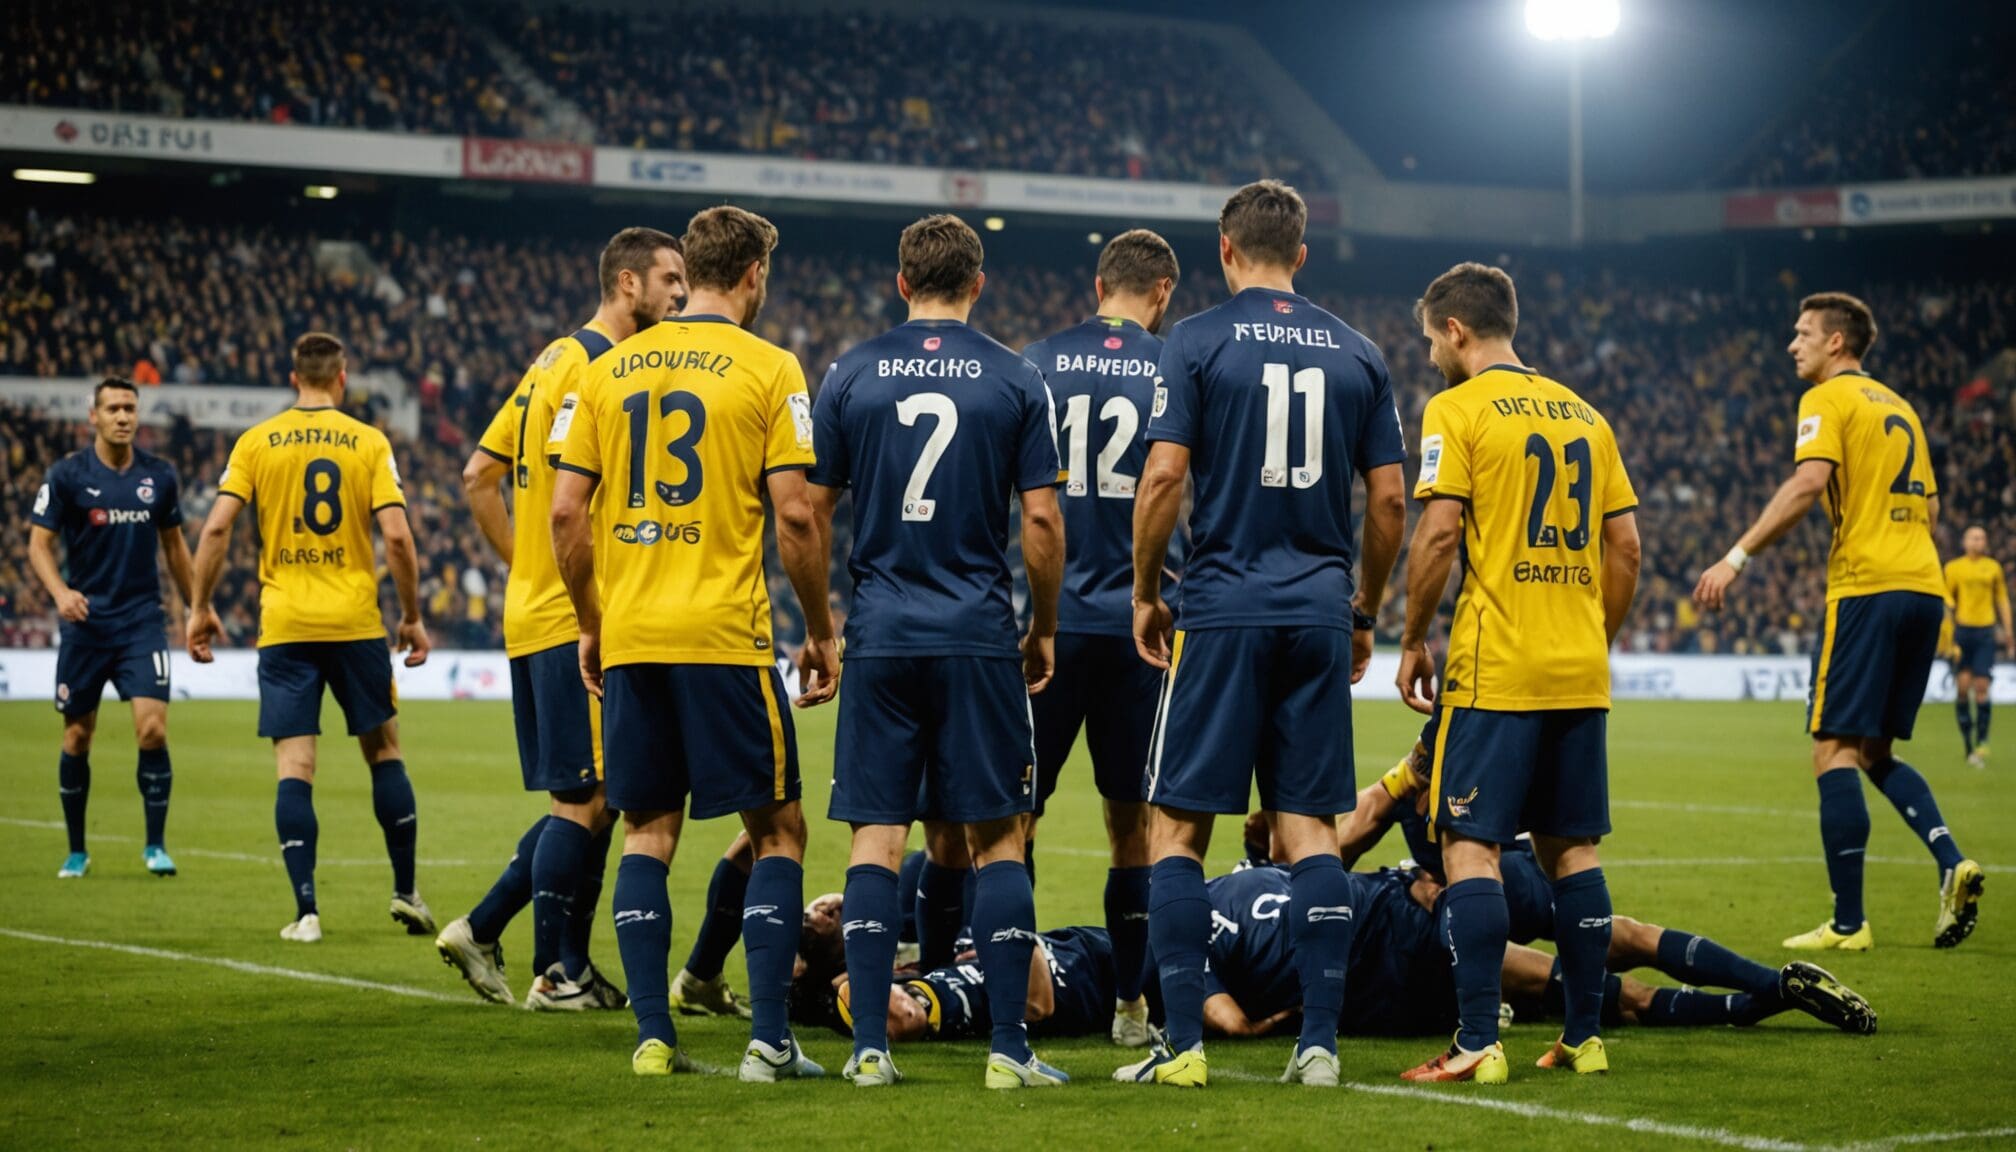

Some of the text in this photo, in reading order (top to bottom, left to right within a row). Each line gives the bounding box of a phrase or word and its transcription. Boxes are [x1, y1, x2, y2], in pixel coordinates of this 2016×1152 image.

[622, 390, 706, 508] 13
[1061, 395, 1139, 499] 12
[1261, 363, 1326, 489] 11
[303, 457, 343, 536] 8
[1525, 433, 1592, 551] 23
